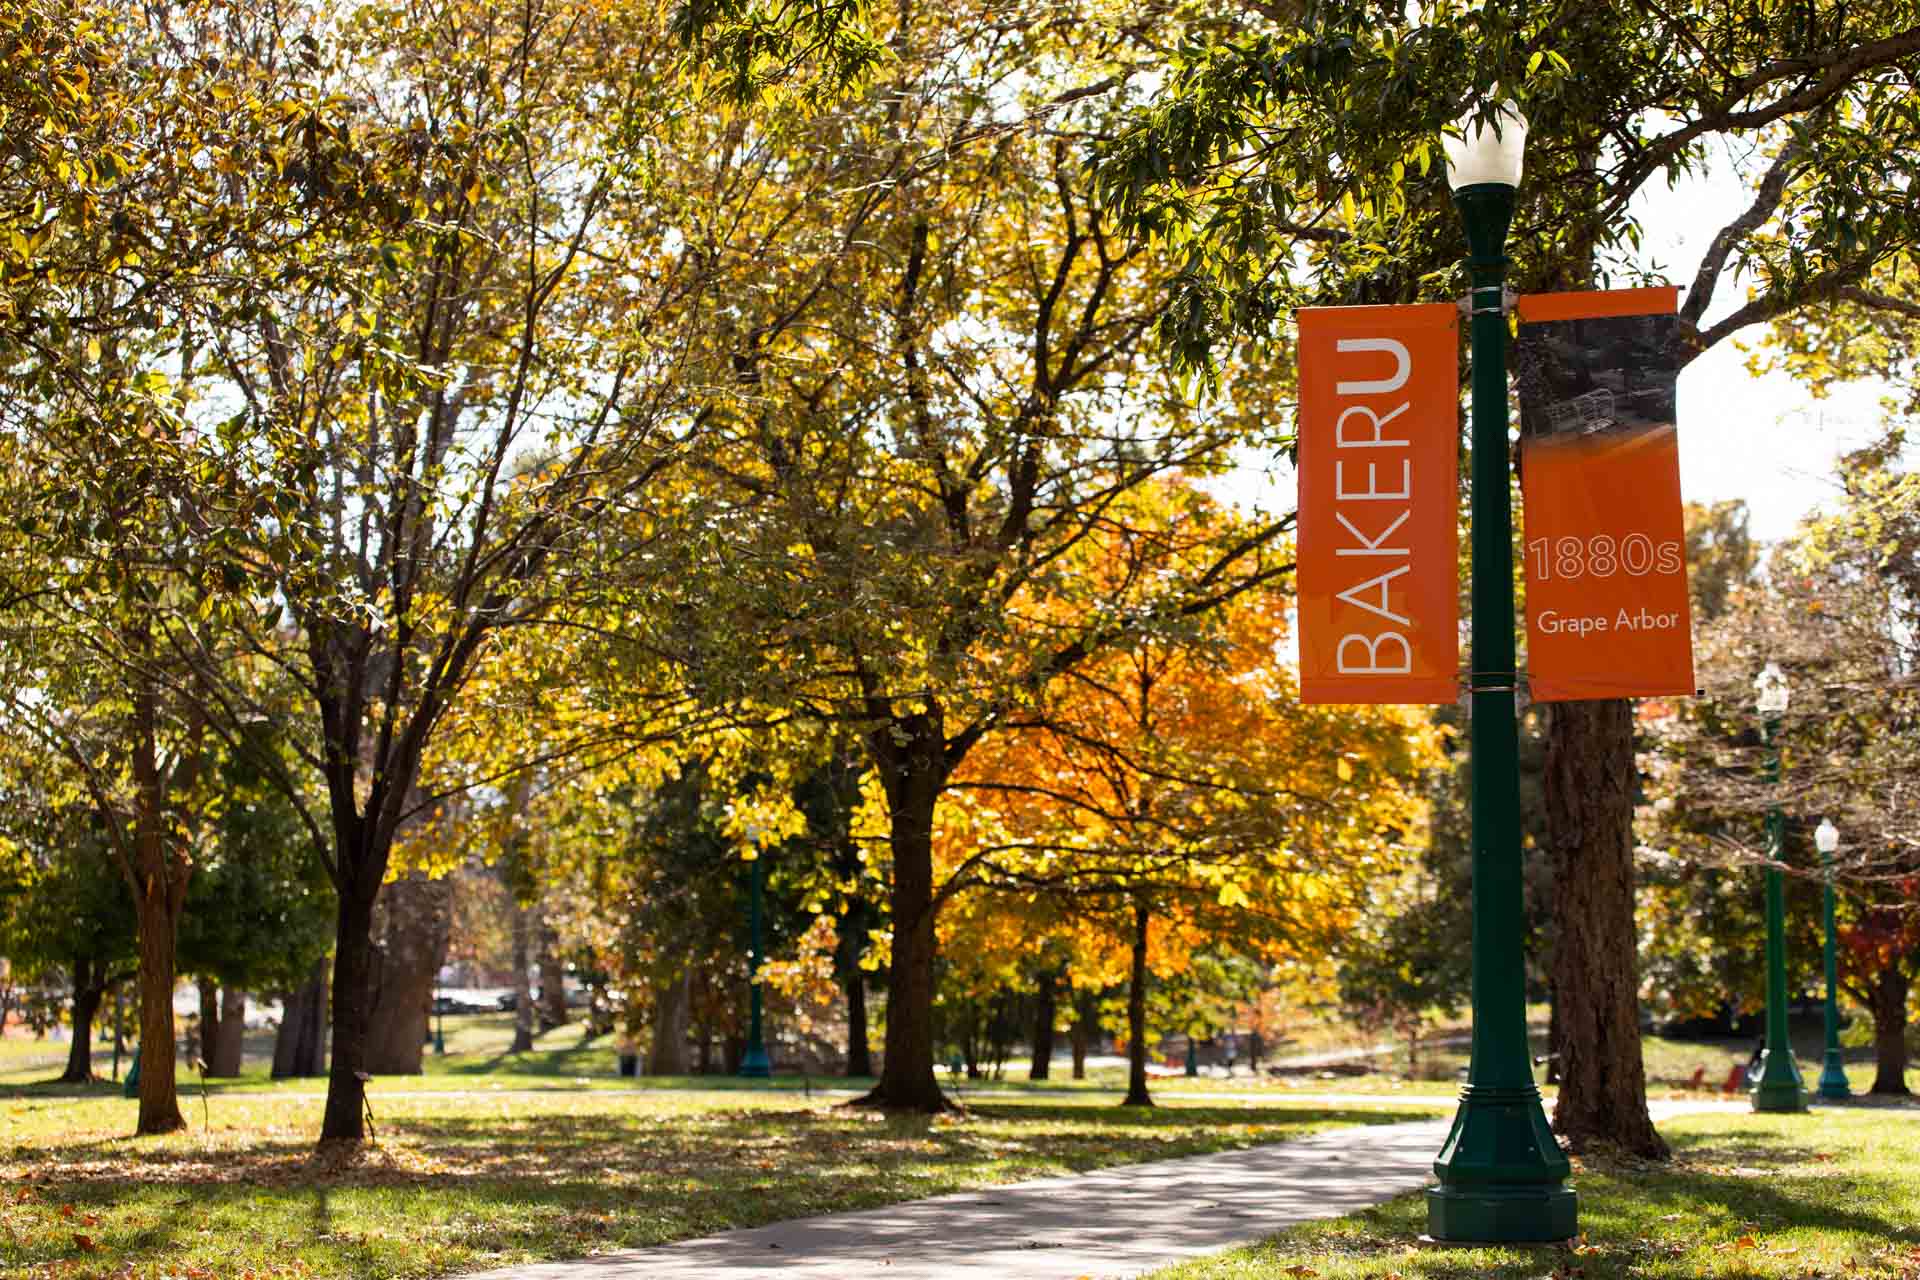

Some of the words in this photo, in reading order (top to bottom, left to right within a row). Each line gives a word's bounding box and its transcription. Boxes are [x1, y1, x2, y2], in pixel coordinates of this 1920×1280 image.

[1336, 338, 1411, 674] BAKERU
[1529, 533, 1681, 580] 1880s
[1538, 610, 1607, 638] Grape
[1615, 607, 1679, 631] Arbor
